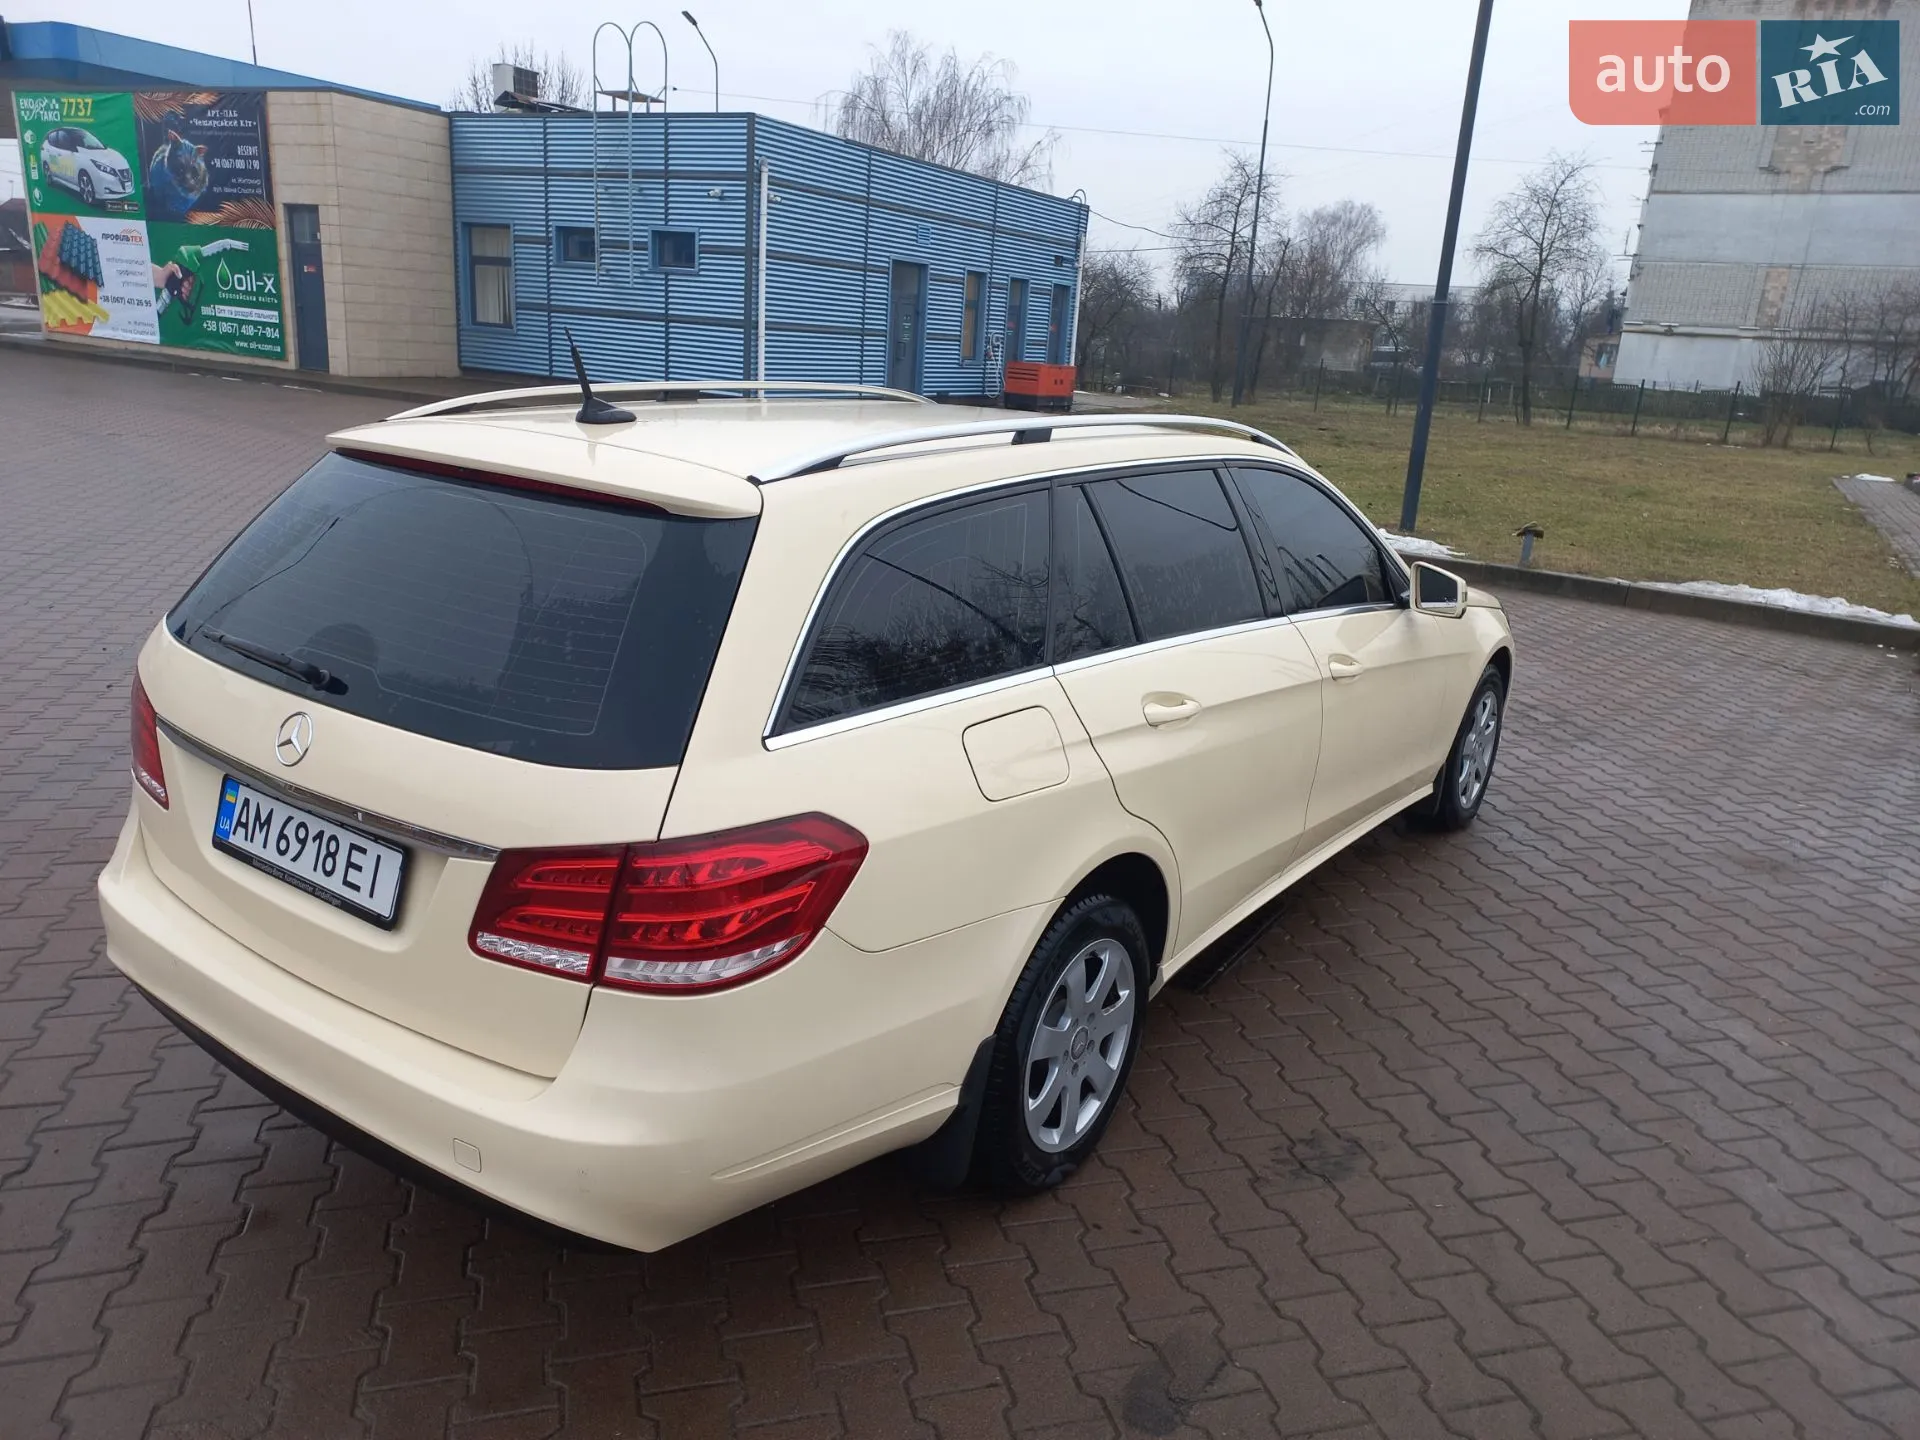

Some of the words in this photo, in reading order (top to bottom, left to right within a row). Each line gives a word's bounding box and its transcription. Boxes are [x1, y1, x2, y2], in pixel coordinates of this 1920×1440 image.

[61, 97, 93, 117] 7737
[207, 109, 239, 118] АРТ-ПАБ
[237, 145, 259, 156] RESERVE
[233, 270, 277, 294] oil-x
[202, 320, 217, 331] +38
[218, 321, 239, 336] (067)
[219, 818, 230, 832] UA
[232, 797, 274, 850] AM
[276, 815, 340, 878] 6918
[342, 842, 382, 899] EI
